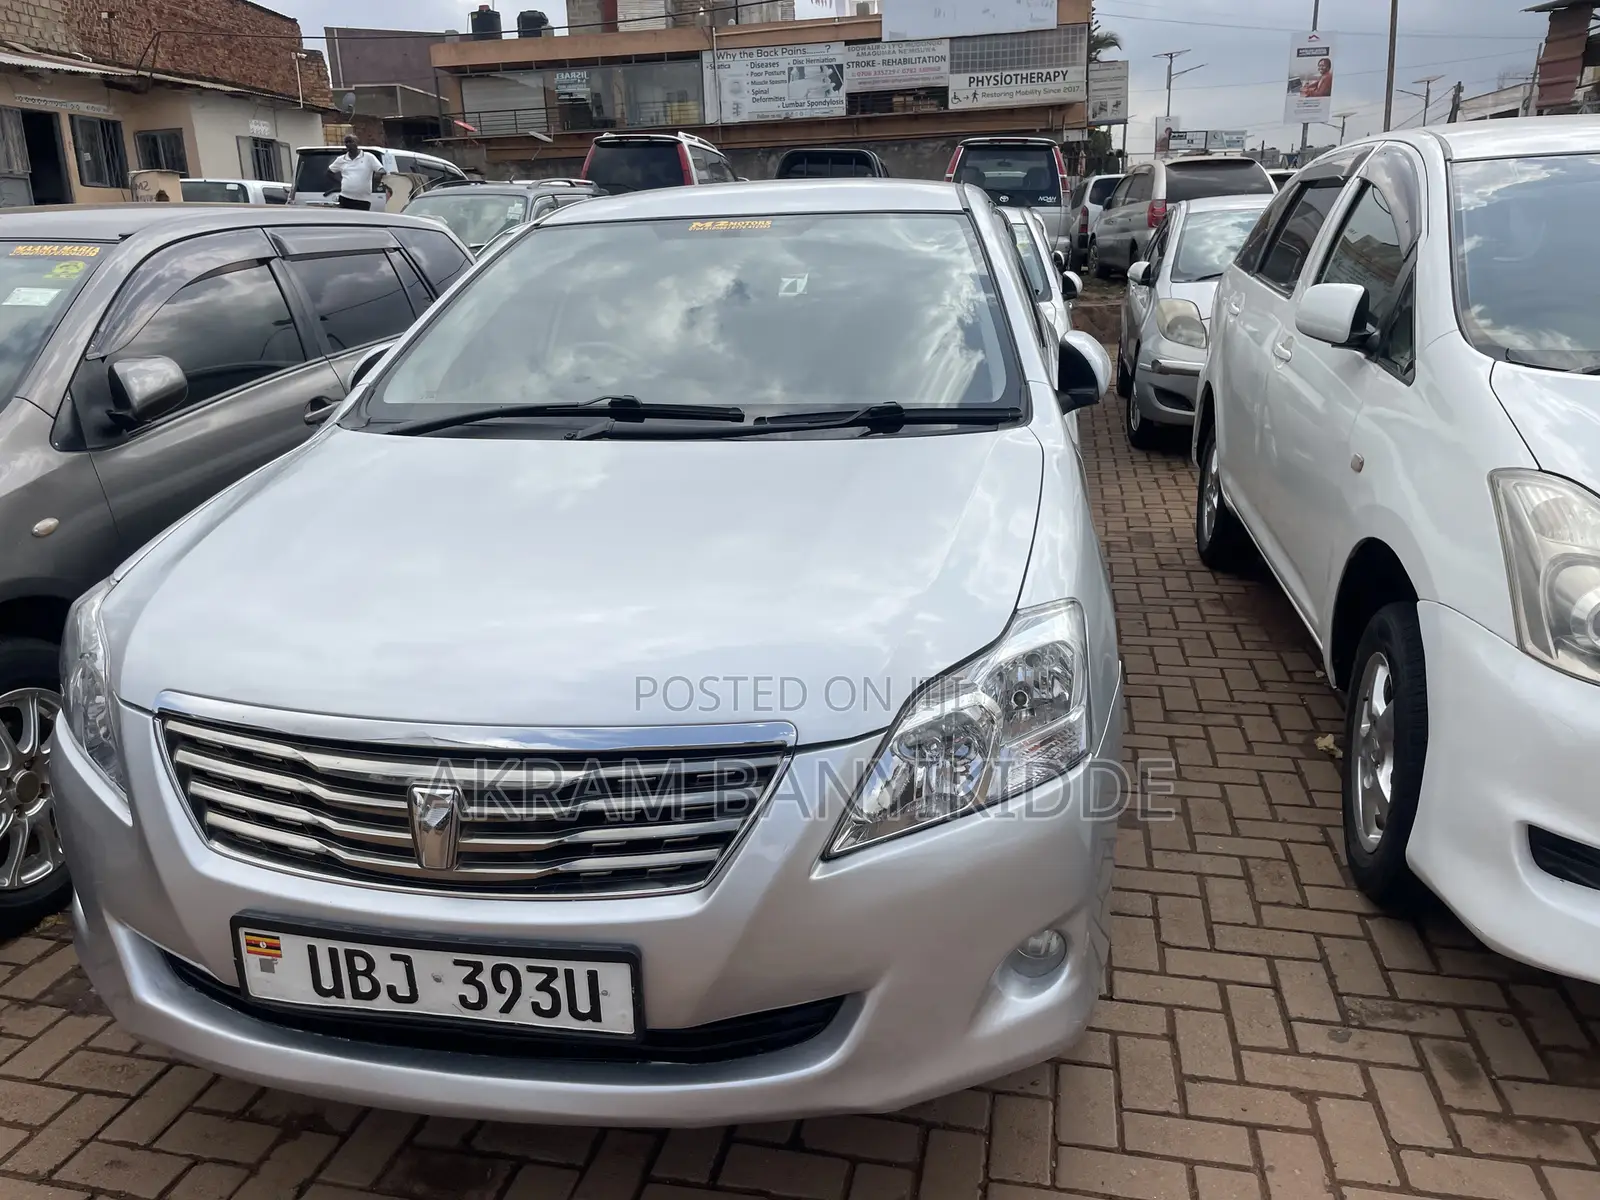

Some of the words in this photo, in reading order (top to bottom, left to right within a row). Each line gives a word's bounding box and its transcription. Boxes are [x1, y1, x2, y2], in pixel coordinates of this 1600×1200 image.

[716, 50, 737, 61] Why
[739, 49, 754, 59] the
[756, 47, 779, 58] Back
[750, 61, 780, 69] Diseases
[805, 57, 837, 65] Herniation
[846, 60, 876, 69] STROKE
[881, 55, 947, 67] REHABILITATION
[751, 88, 770, 96] Spinal
[981, 90, 1014, 99] Restoring
[1015, 88, 1041, 97] Mobility
[1043, 87, 1061, 95] Since
[781, 101, 805, 109] Lumbar
[806, 99, 844, 108] Spondylosis
[307, 943, 420, 1004] UBJ
[452, 957, 603, 1023] 393U
